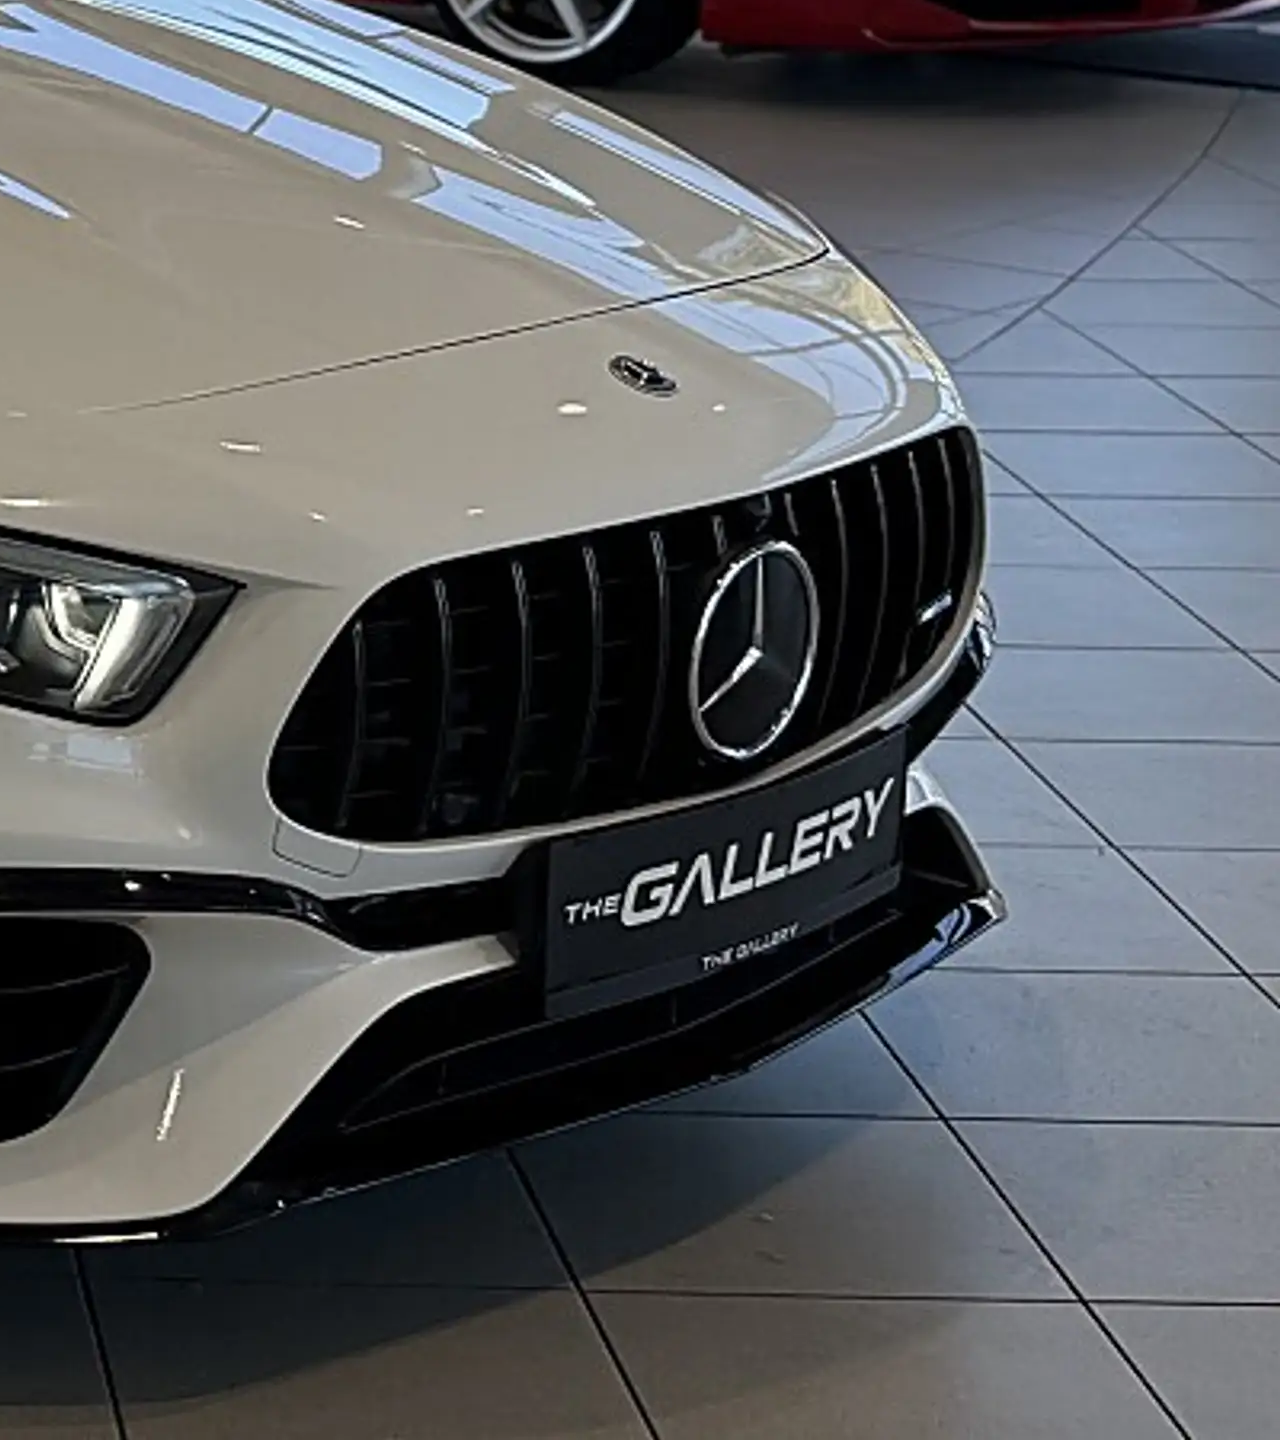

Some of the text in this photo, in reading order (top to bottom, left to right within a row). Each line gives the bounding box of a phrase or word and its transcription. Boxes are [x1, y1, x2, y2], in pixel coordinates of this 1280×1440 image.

[564, 776, 896, 926] THE GALLERY
[701, 921, 800, 971] THE GALLERY
